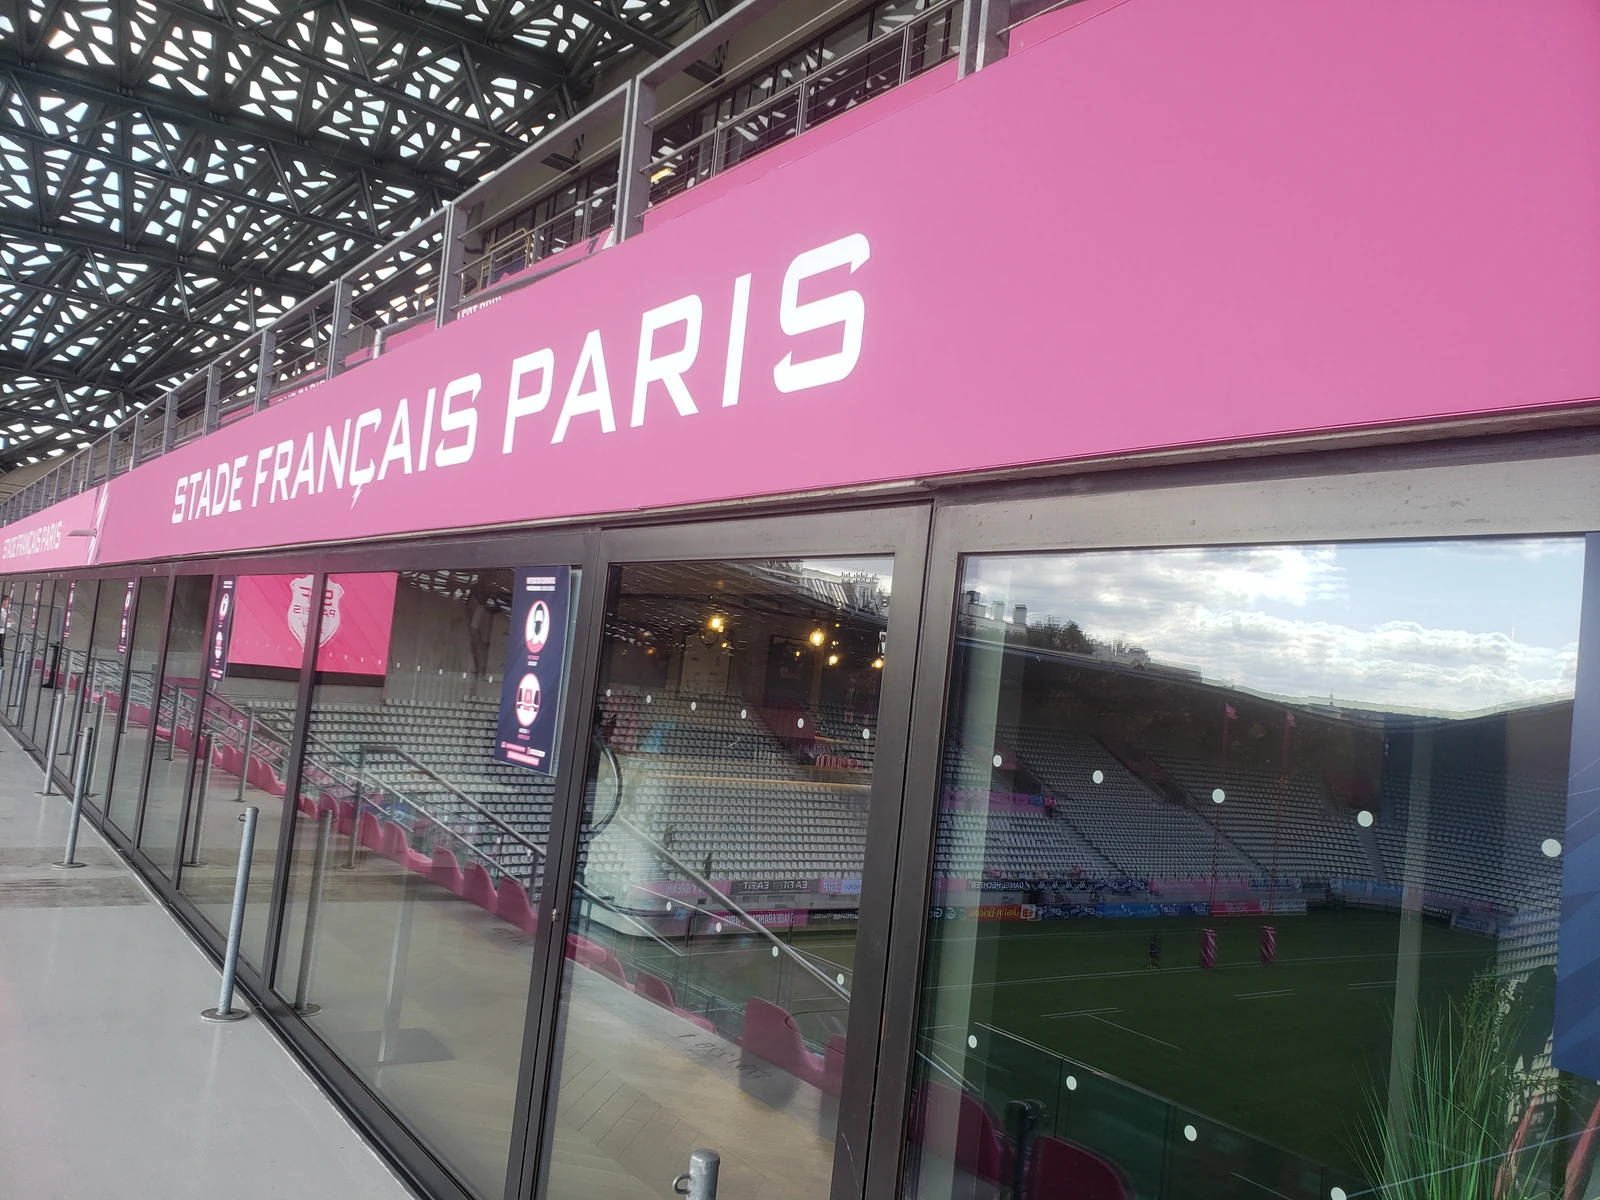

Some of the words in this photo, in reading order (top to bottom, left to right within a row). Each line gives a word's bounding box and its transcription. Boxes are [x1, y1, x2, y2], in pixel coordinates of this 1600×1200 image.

[171, 455, 249, 524] STADE
[251, 372, 482, 510] FRANÇAIS
[502, 232, 871, 455] PARIS
[41, 520, 63, 552] PARIS
